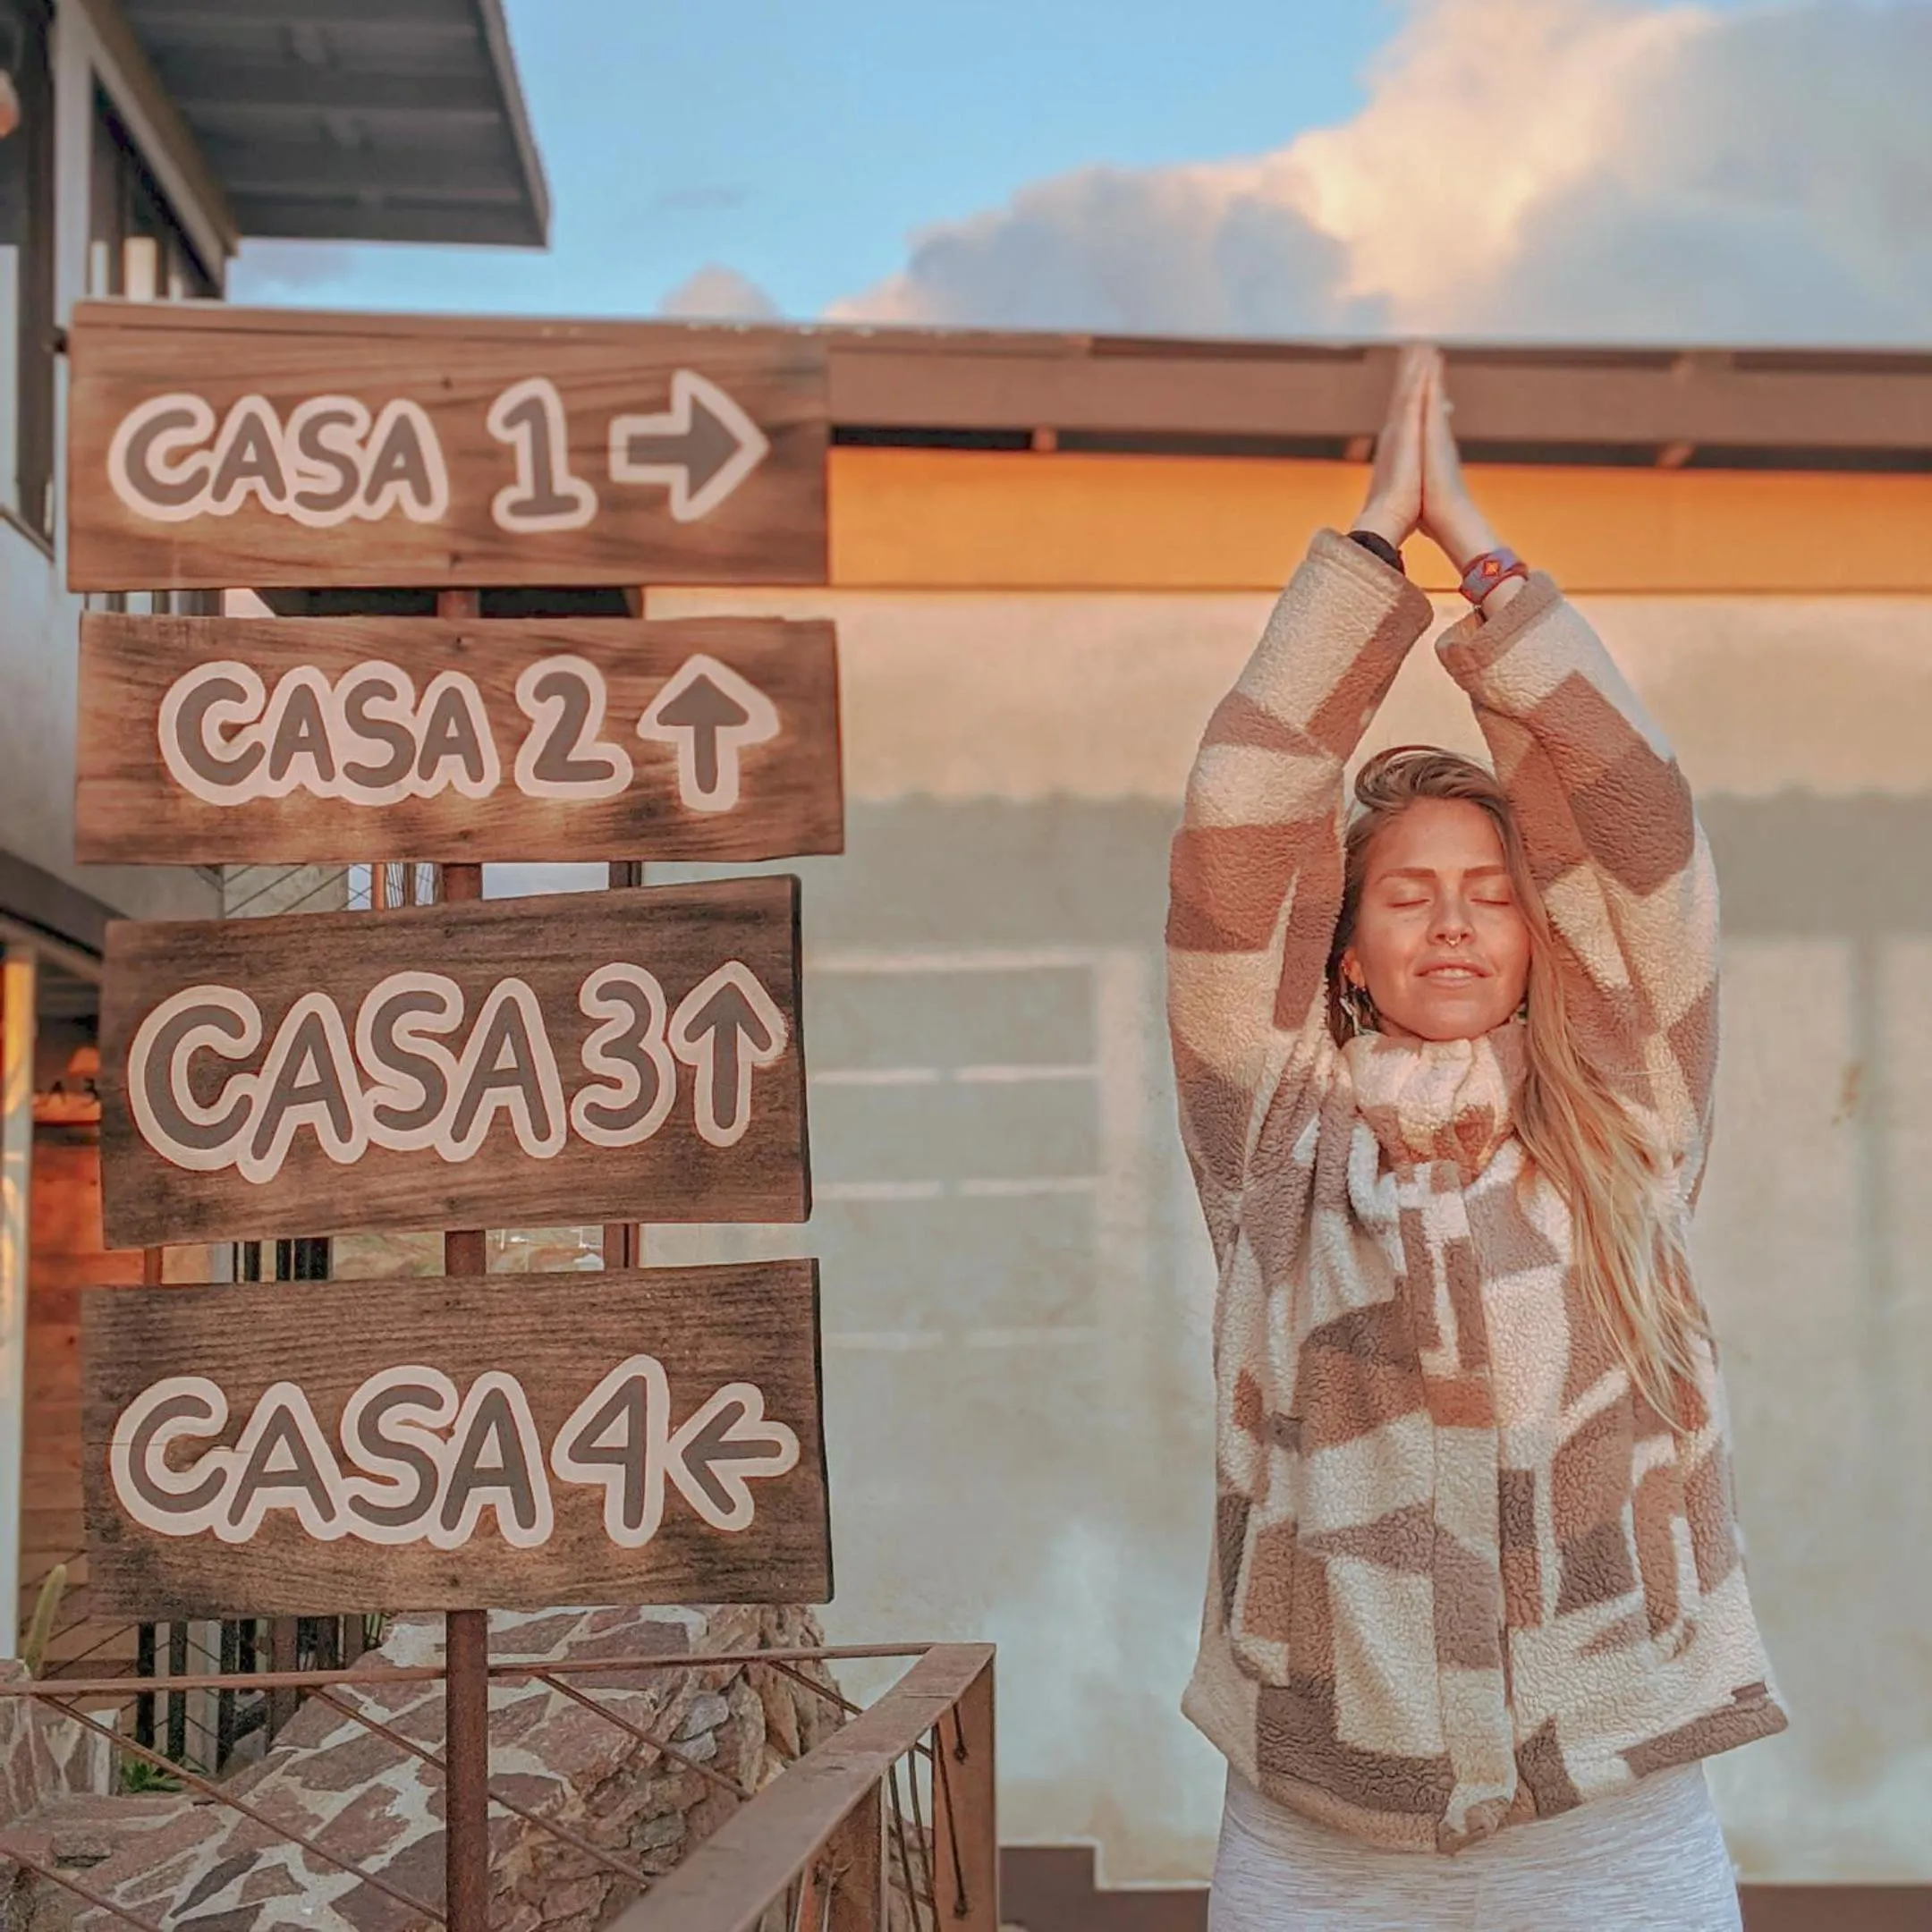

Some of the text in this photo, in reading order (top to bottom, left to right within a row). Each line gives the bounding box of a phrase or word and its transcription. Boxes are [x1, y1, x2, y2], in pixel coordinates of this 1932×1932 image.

[107, 378, 597, 531] CASA 1
[158, 656, 633, 806] CASA 2
[128, 962, 676, 1184] CASA 3
[110, 1354, 669, 1549] CASA 4
